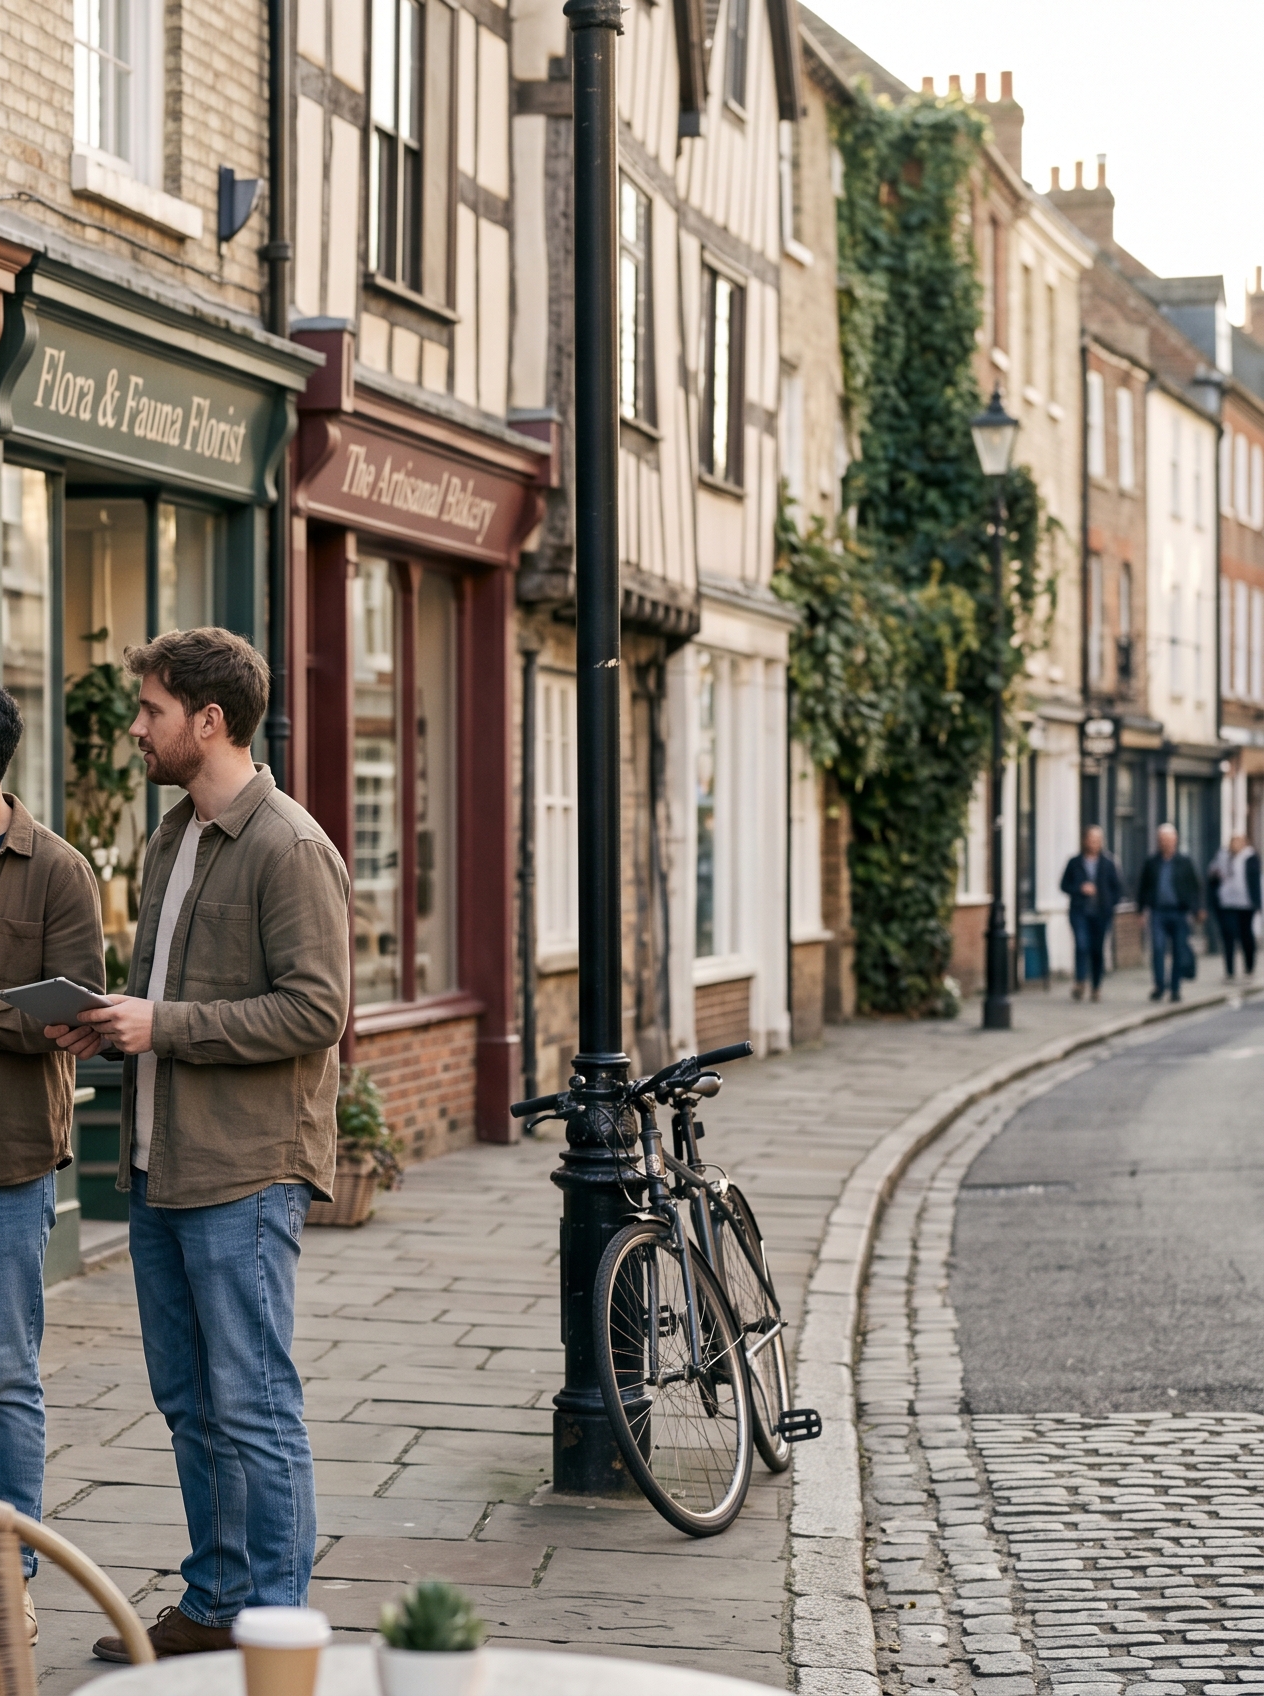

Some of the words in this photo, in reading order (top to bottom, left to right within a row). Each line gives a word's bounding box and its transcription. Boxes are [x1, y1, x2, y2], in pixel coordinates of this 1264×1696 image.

[34, 347, 96, 422] Flora
[98, 368, 121, 429] &
[120, 375, 184, 447] Fauna
[183, 396, 247, 466] Florist
[341, 443, 376, 499] The
[372, 454, 450, 519] Artisanal
[440, 475, 497, 545] Bakery
